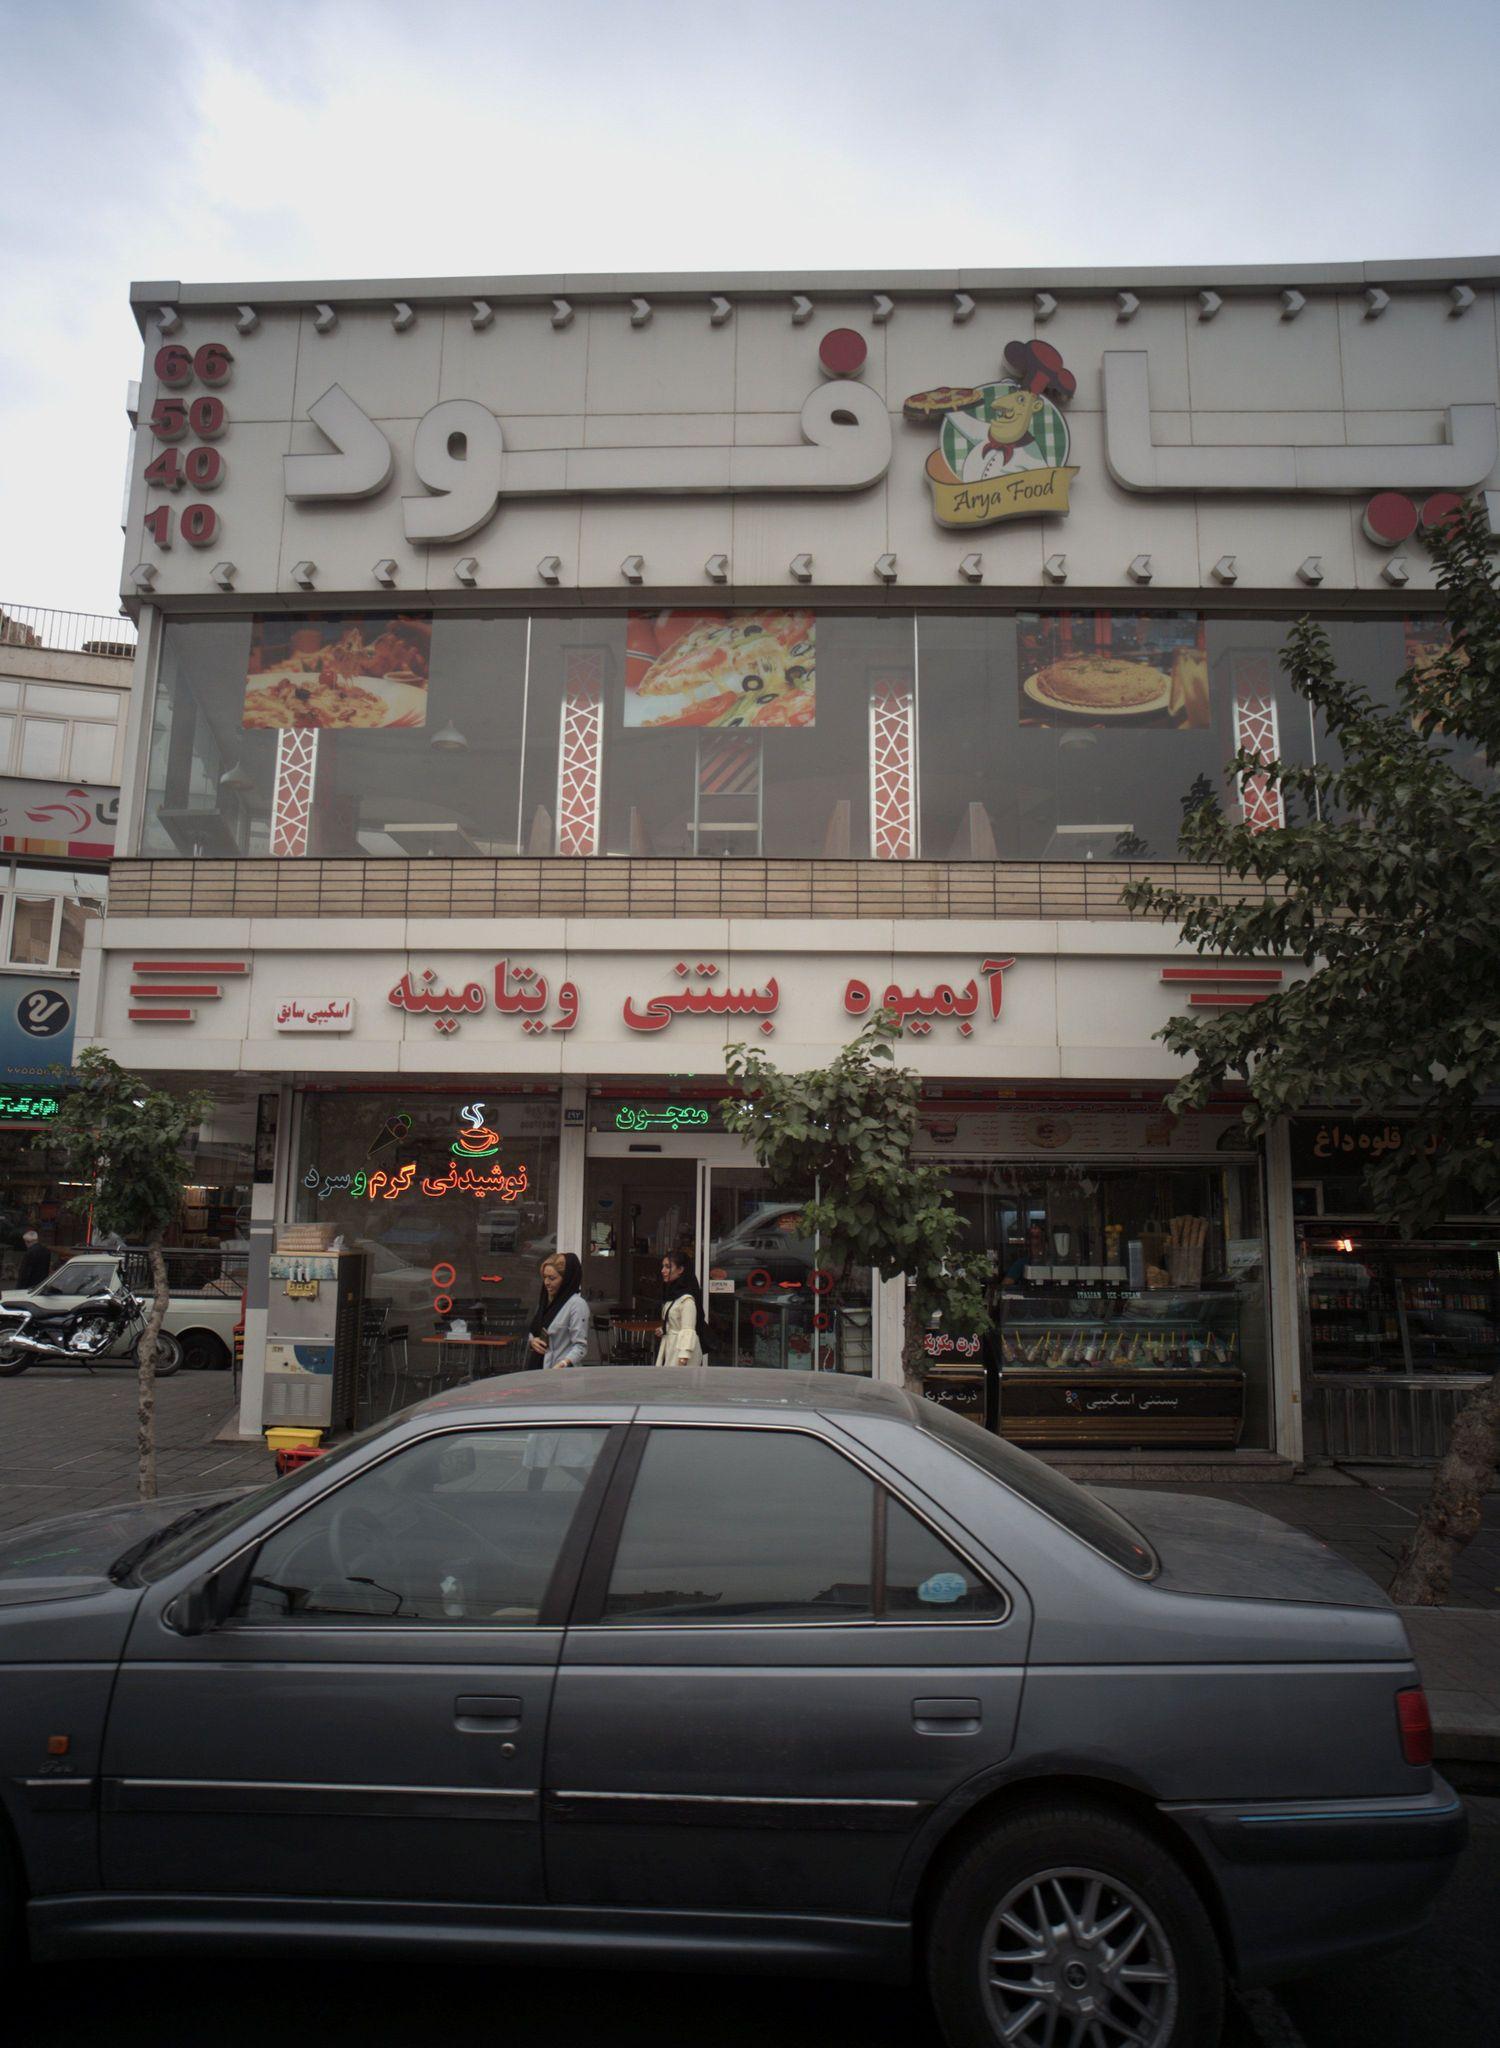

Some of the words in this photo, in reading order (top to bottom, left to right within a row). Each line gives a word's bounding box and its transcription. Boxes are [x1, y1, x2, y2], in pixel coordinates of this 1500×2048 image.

[154, 343, 234, 388] 66
[149, 396, 228, 441] 50
[283, 328, 892, 545] فود
[1101, 350, 1500, 548] یا
[144, 447, 226, 491] 40
[953, 489, 1002, 519] Arya
[1006, 472, 1055, 501] Food
[144, 503, 220, 550] 10
[276, 1001, 305, 1024] سابق
[306, 1001, 351, 1025] اسکیپی
[387, 958, 578, 1034] ویتامینه
[622, 961, 780, 1036] بستنی
[843, 956, 1017, 1037] آبمیوه
[615, 1105, 709, 1130] معجون
[1313, 1125, 1355, 1158] داغ
[1357, 1122, 1403, 1157] قلوه
[304, 1166, 351, 1198] سرد
[351, 1169, 368, 1197] و
[368, 1164, 417, 1200] گرم
[421, 1160, 528, 1201] نوشیدنی
[956, 1332, 981, 1357] ذرت
[956, 1389, 978, 1405] ذرت
[1086, 1392, 1136, 1411] اسکیپی
[1137, 1394, 1179, 1410] بستنی
